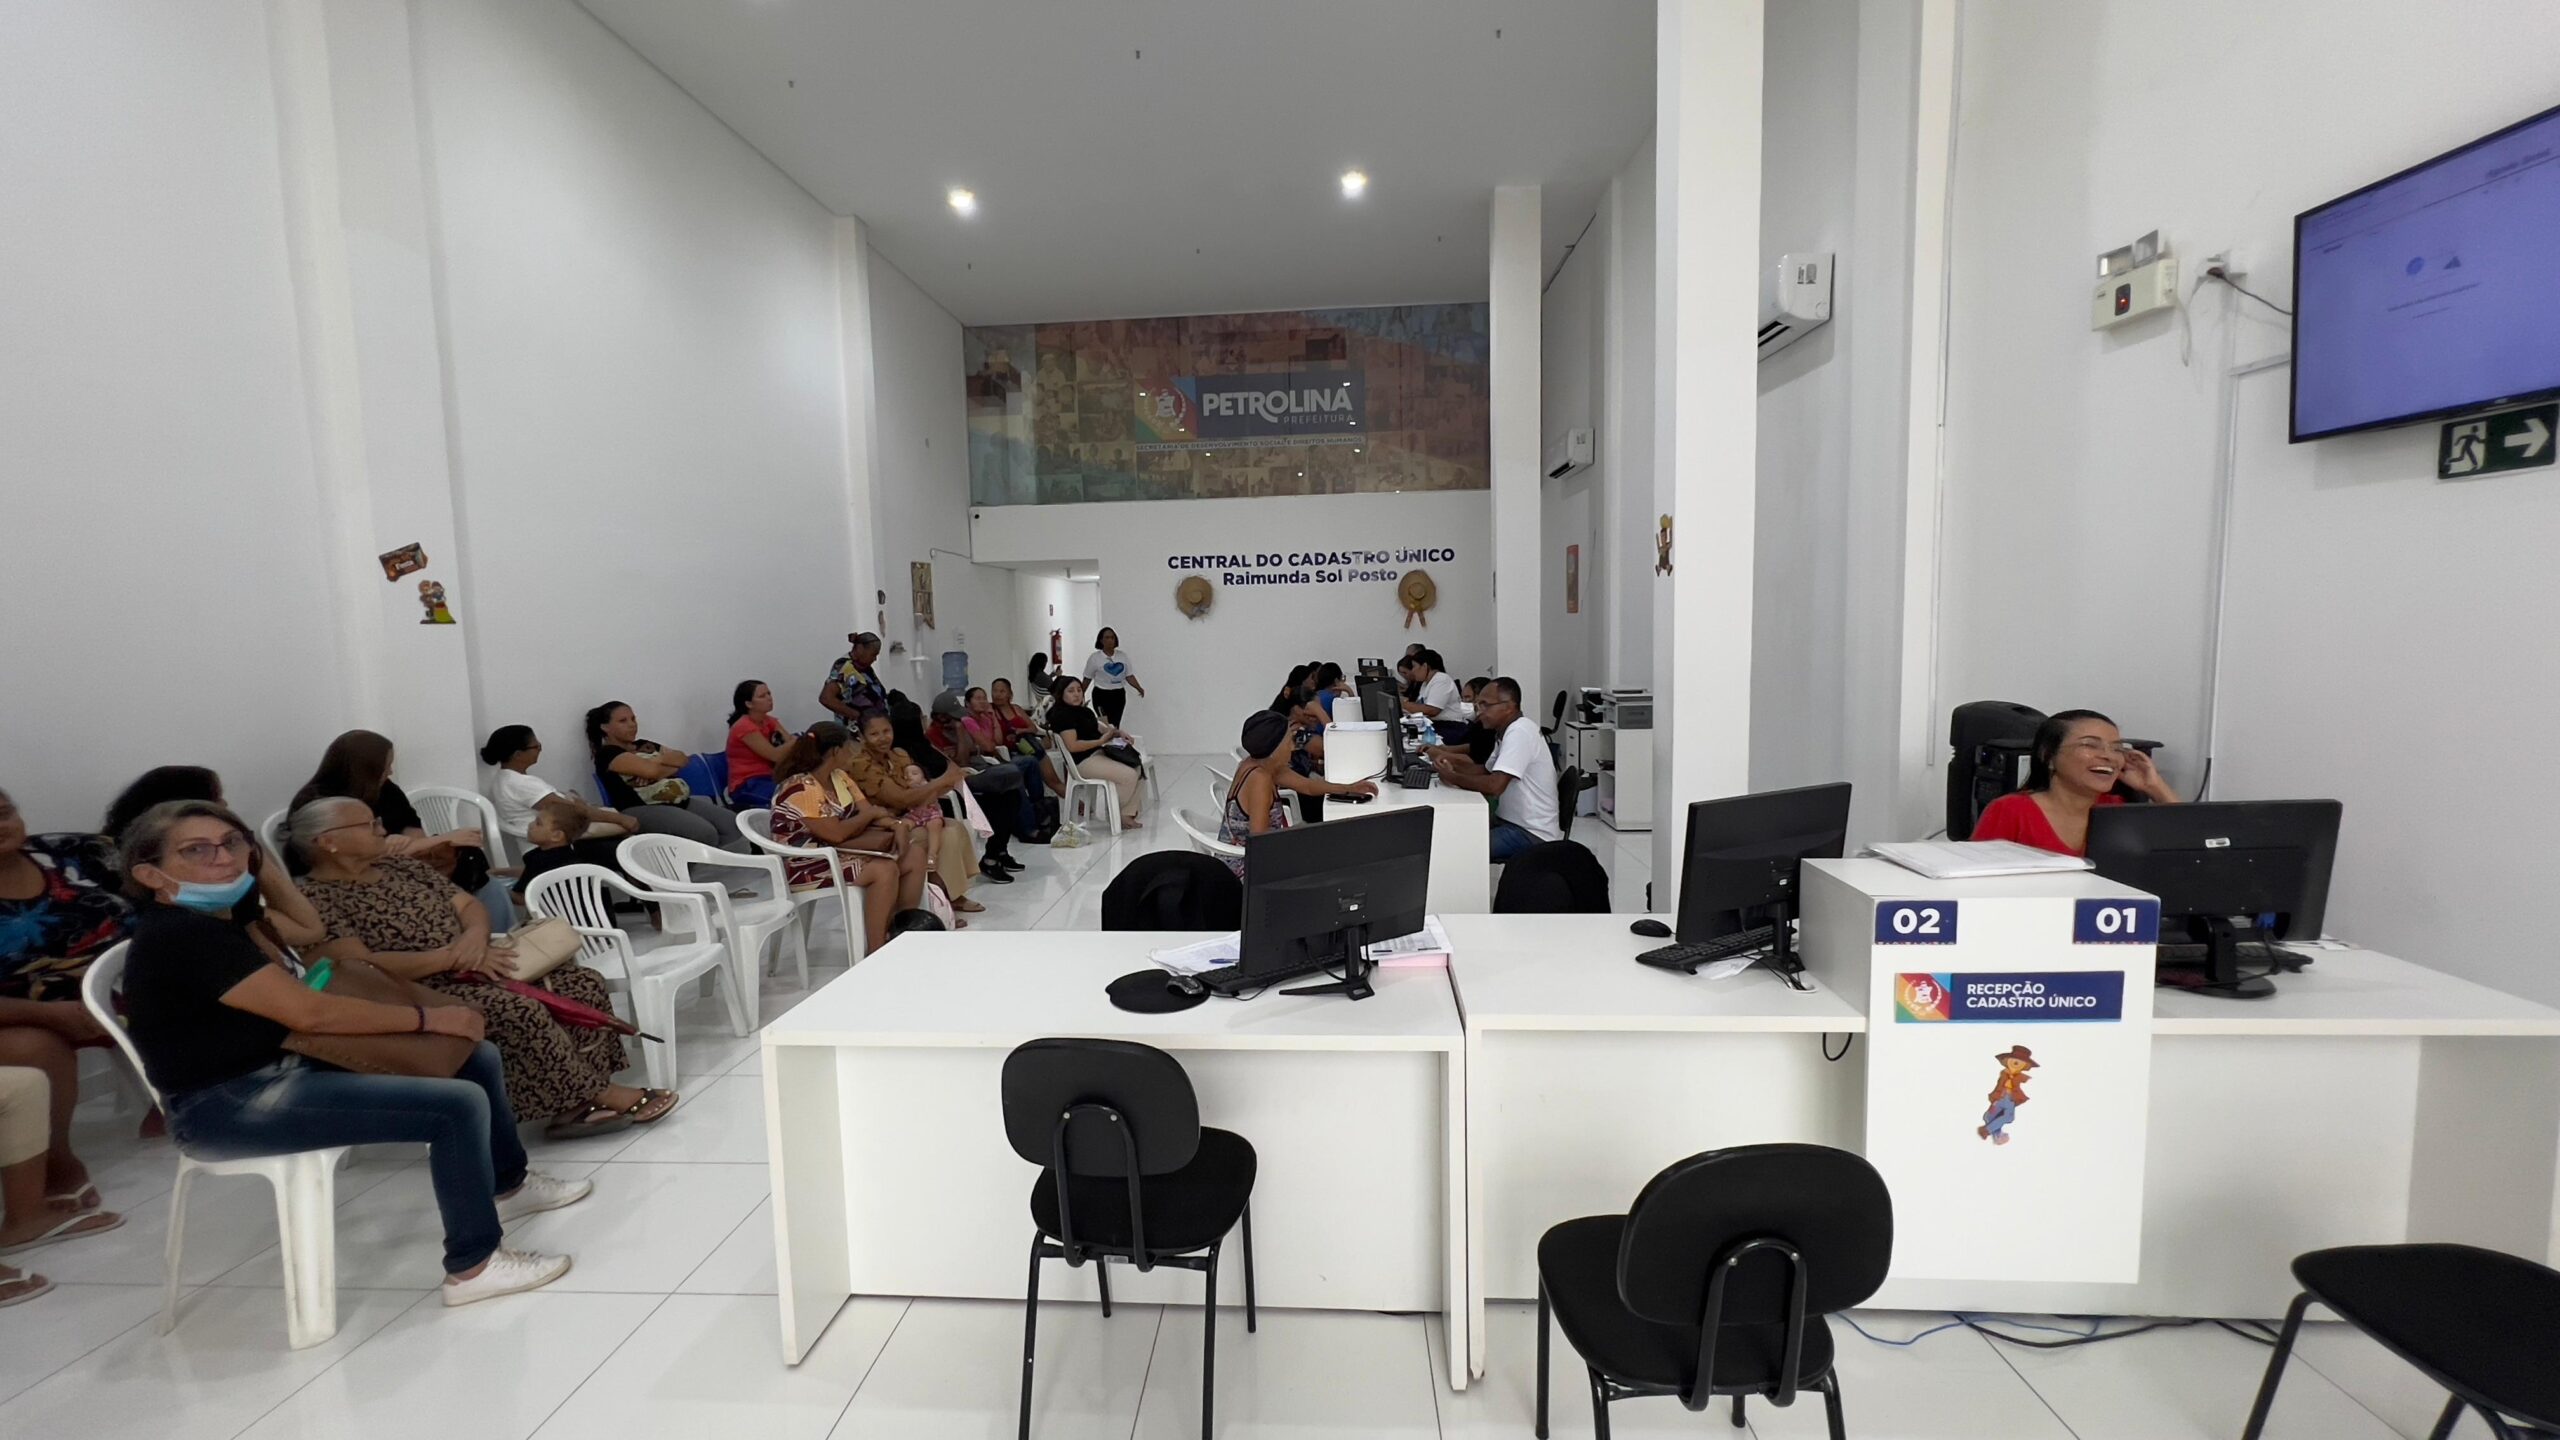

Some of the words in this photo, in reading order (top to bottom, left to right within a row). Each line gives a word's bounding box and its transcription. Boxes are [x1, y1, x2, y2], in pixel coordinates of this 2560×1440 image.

[1203, 387, 1353, 423] PETROLINA
[1283, 414, 1354, 425] PREFEITURA
[1167, 553, 1252, 569] CENTRAL
[1256, 553, 1283, 567] DO
[1288, 550, 1390, 567] CADASTRO
[1396, 546, 1455, 563] ÚNICO
[1223, 569, 1310, 586] Raimunda
[1315, 568, 1343, 583] Sol
[1348, 568, 1398, 583] Posto
[1892, 907, 1941, 934] 02
[2095, 907, 2137, 934] 01
[1966, 981, 2045, 997] RECEPÇÃO
[1966, 996, 2046, 1009] CADASTRO
[2049, 994, 2097, 1008] ÚNICO
